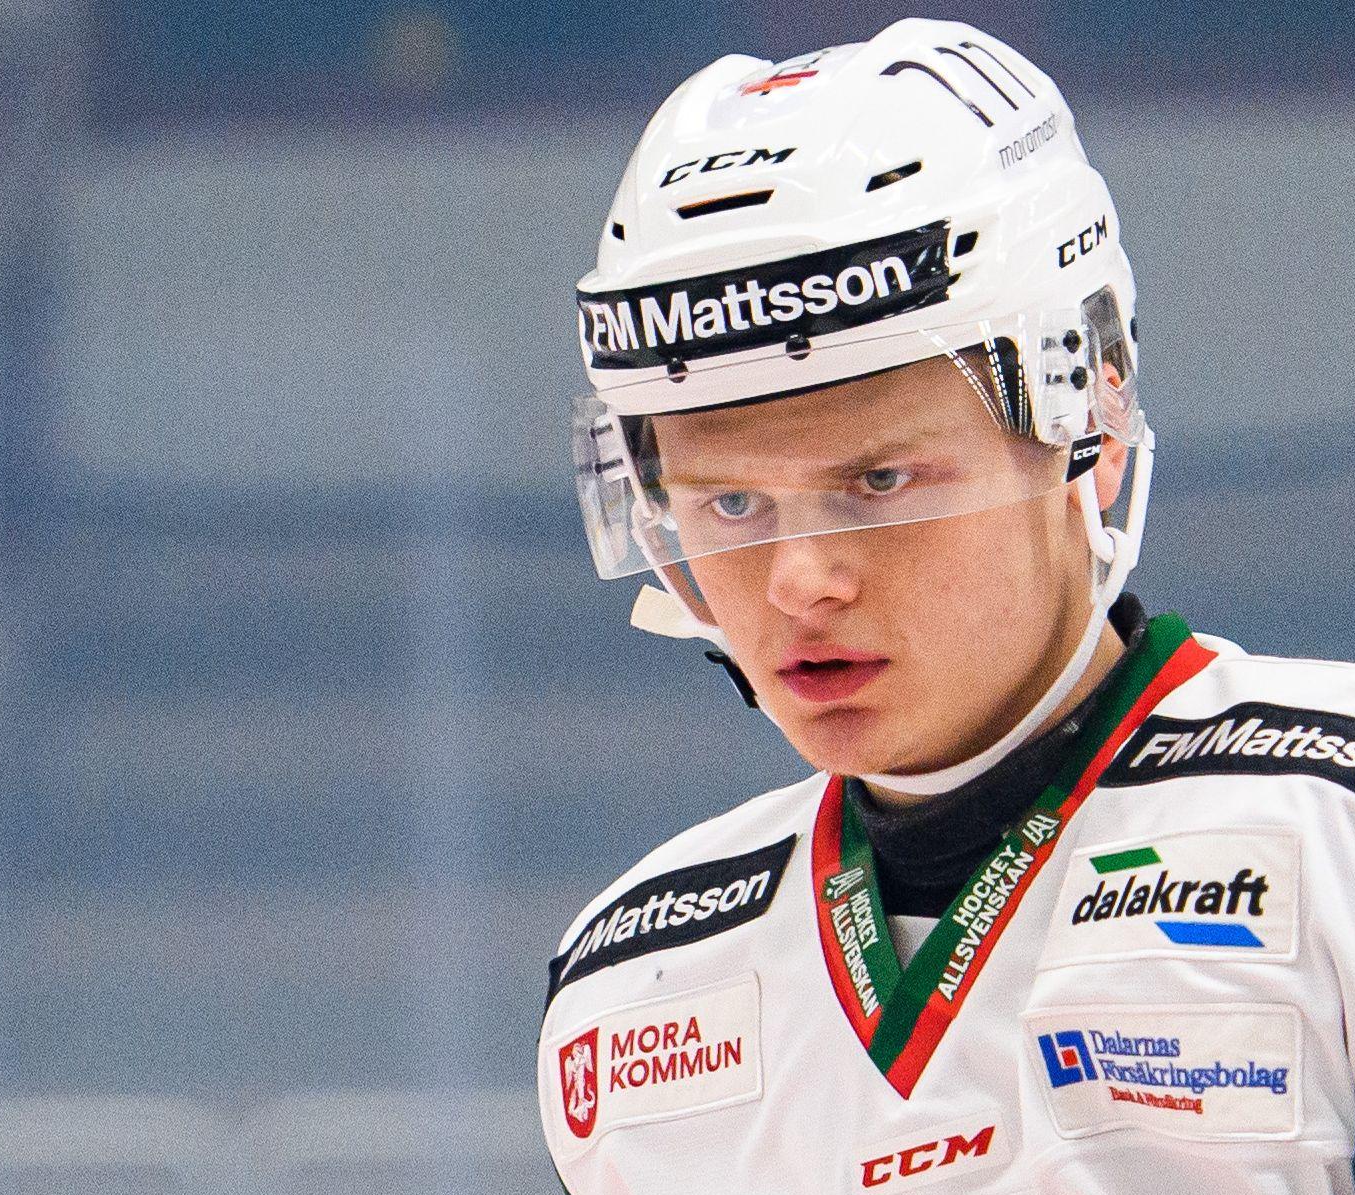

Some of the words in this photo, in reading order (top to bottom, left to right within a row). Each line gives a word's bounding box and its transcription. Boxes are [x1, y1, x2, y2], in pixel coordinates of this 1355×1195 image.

[659, 147, 799, 188] CCM
[1056, 214, 1108, 269] CCM
[640, 255, 912, 348] Mattsson
[952, 844, 1016, 928] HOCKEY
[1072, 869, 1269, 926] dalakraft
[848, 888, 880, 951] HOCKEY
[937, 851, 1035, 1001] ALLSVENSKAN
[830, 902, 880, 1019] ALLSVENSKAN
[607, 1036, 743, 1093] KOMMUN
[610, 1015, 700, 1061] MORA
[1089, 1029, 1181, 1057] Dalarnas
[859, 1124, 997, 1190] CCM
